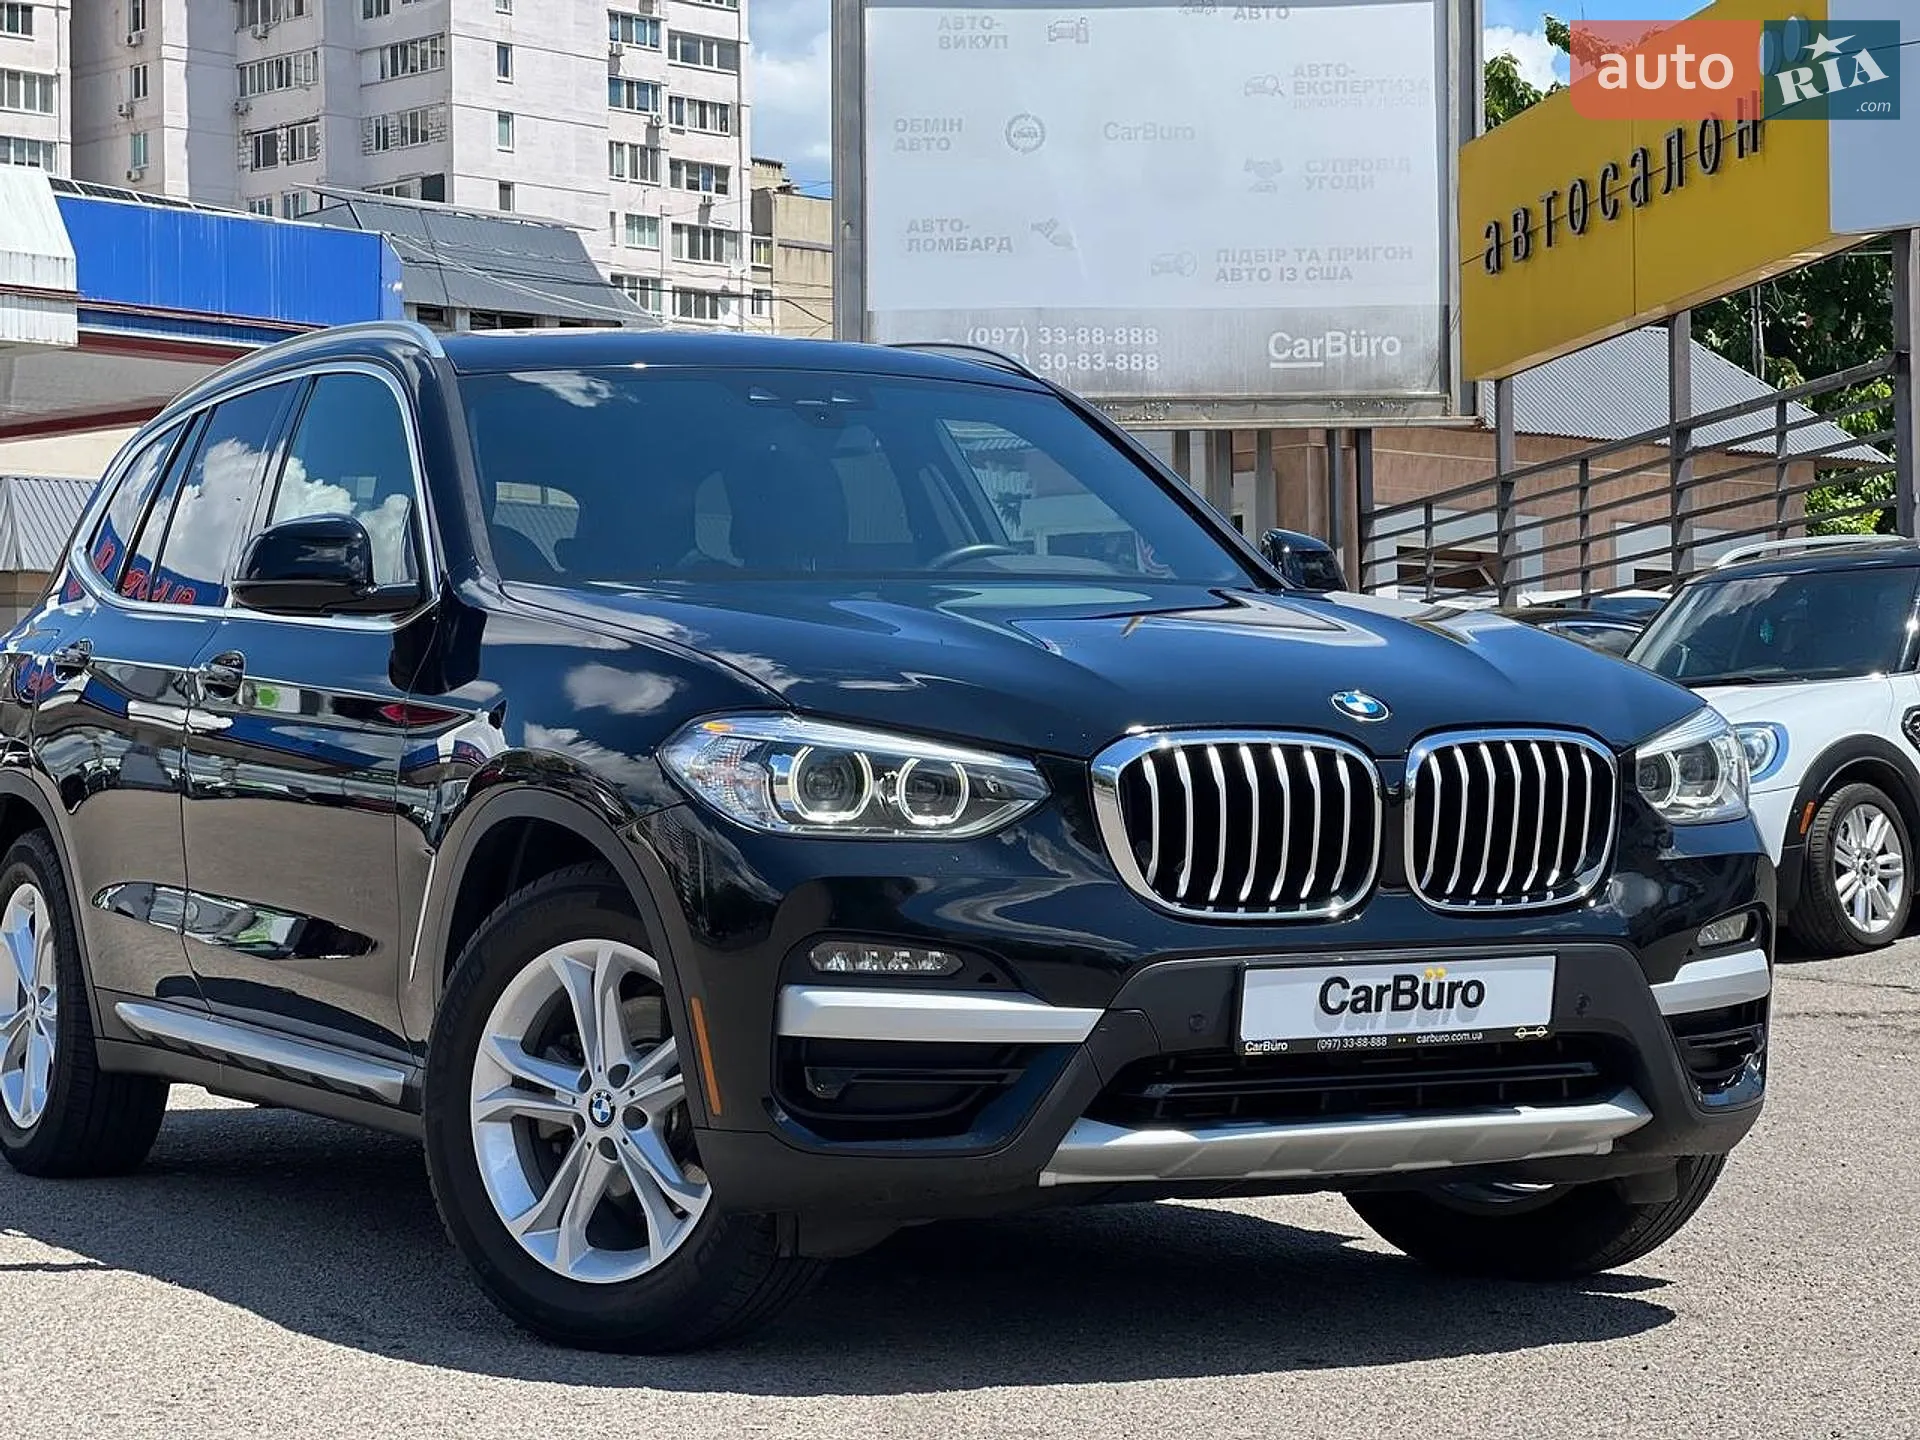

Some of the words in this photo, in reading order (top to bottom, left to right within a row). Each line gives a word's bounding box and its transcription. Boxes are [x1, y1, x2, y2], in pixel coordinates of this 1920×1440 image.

[1233, 5, 1290, 21] АВТО
[938, 16, 1003, 32] АВТО-
[938, 34, 1009, 50] ВИКУП
[1291, 63, 1357, 79] АВТО-
[893, 117, 964, 135] ОБМІН
[893, 136, 951, 152] АВТО
[1304, 174, 1376, 192] УГОДИ
[1484, 90, 1763, 275] автосалон
[906, 218, 971, 234] АВТО-
[1215, 247, 1287, 265] ПІДБІР
[1293, 247, 1321, 263] ТА
[1327, 246, 1413, 263] ПРИГОН
[1215, 266, 1272, 283] АВТО
[1278, 266, 1298, 282] ІЗ
[1304, 265, 1354, 282] США
[967, 326, 1029, 350] (097)
[1038, 325, 1160, 346] 33-88-888
[1268, 329, 1402, 360] CarBüro
[1039, 352, 1160, 372] 30-83-888
[1318, 967, 1486, 1016] CarBüro
[1316, 1039, 1341, 1051] (097)
[1342, 1036, 1388, 1049] 33-88-888
[1416, 1031, 1484, 1044] carburo.com.ua
